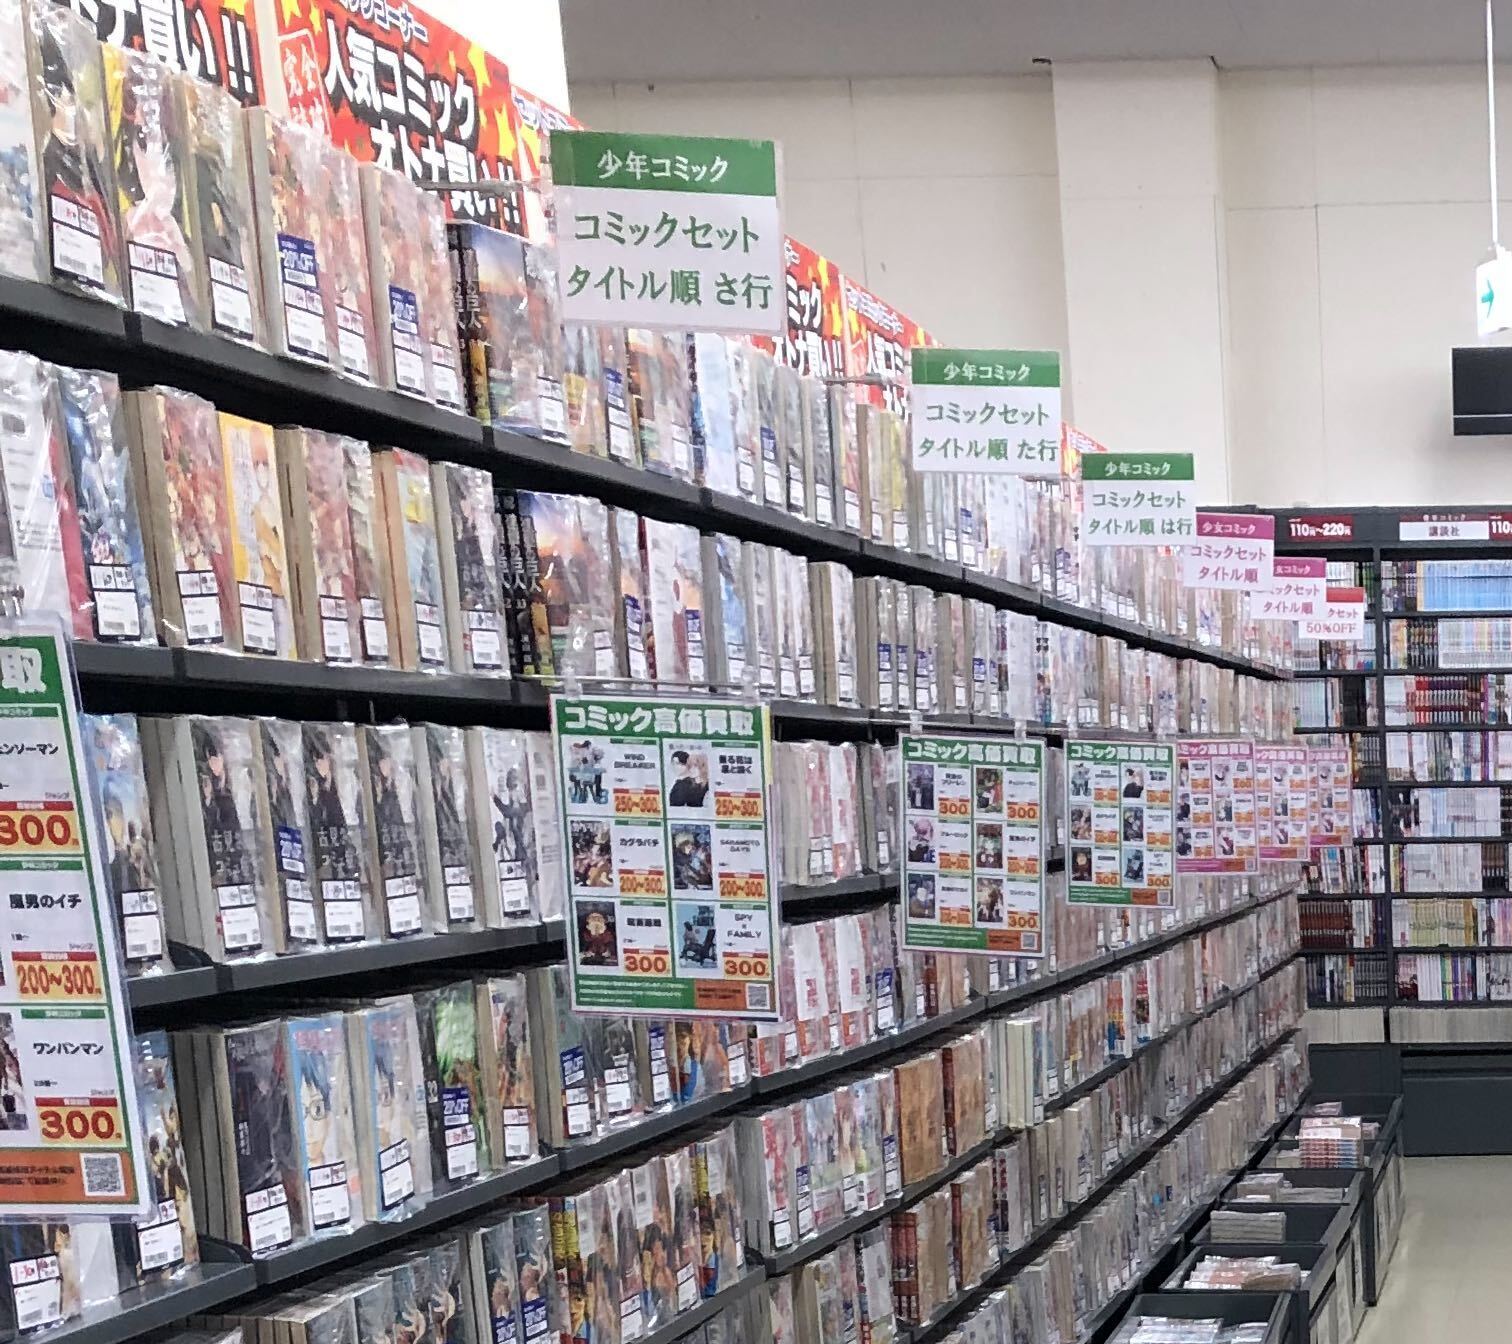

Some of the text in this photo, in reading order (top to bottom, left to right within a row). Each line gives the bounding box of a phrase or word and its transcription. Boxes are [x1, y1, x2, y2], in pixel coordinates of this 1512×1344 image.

[324, 18, 475, 140] 人気コミック
[597, 149, 729, 183] 少年コミック
[574, 211, 760, 253] コミックセット
[566, 264, 774, 310] タイトル順 さ行
[943, 362, 1031, 381] 少年コミック
[926, 401, 1050, 427] コミックセット
[918, 437, 1058, 462] タイトル順 た行
[1105, 462, 1171, 476] 少年コミック
[1092, 489, 1186, 508] コミックセット
[1087, 518, 1192, 536] タイトル順 は行
[1202, 521, 1256, 535] 少女コミック
[1191, 545, 1267, 561] コミックセット
[1198, 567, 1259, 583] タイトル順
[1274, 564, 1311, 576] 女コミック
[1306, 623, 1356, 634] 50%OFF
[564, 705, 755, 736] コミック高価買取
[33, 1042, 104, 1055] ワンパンマン
